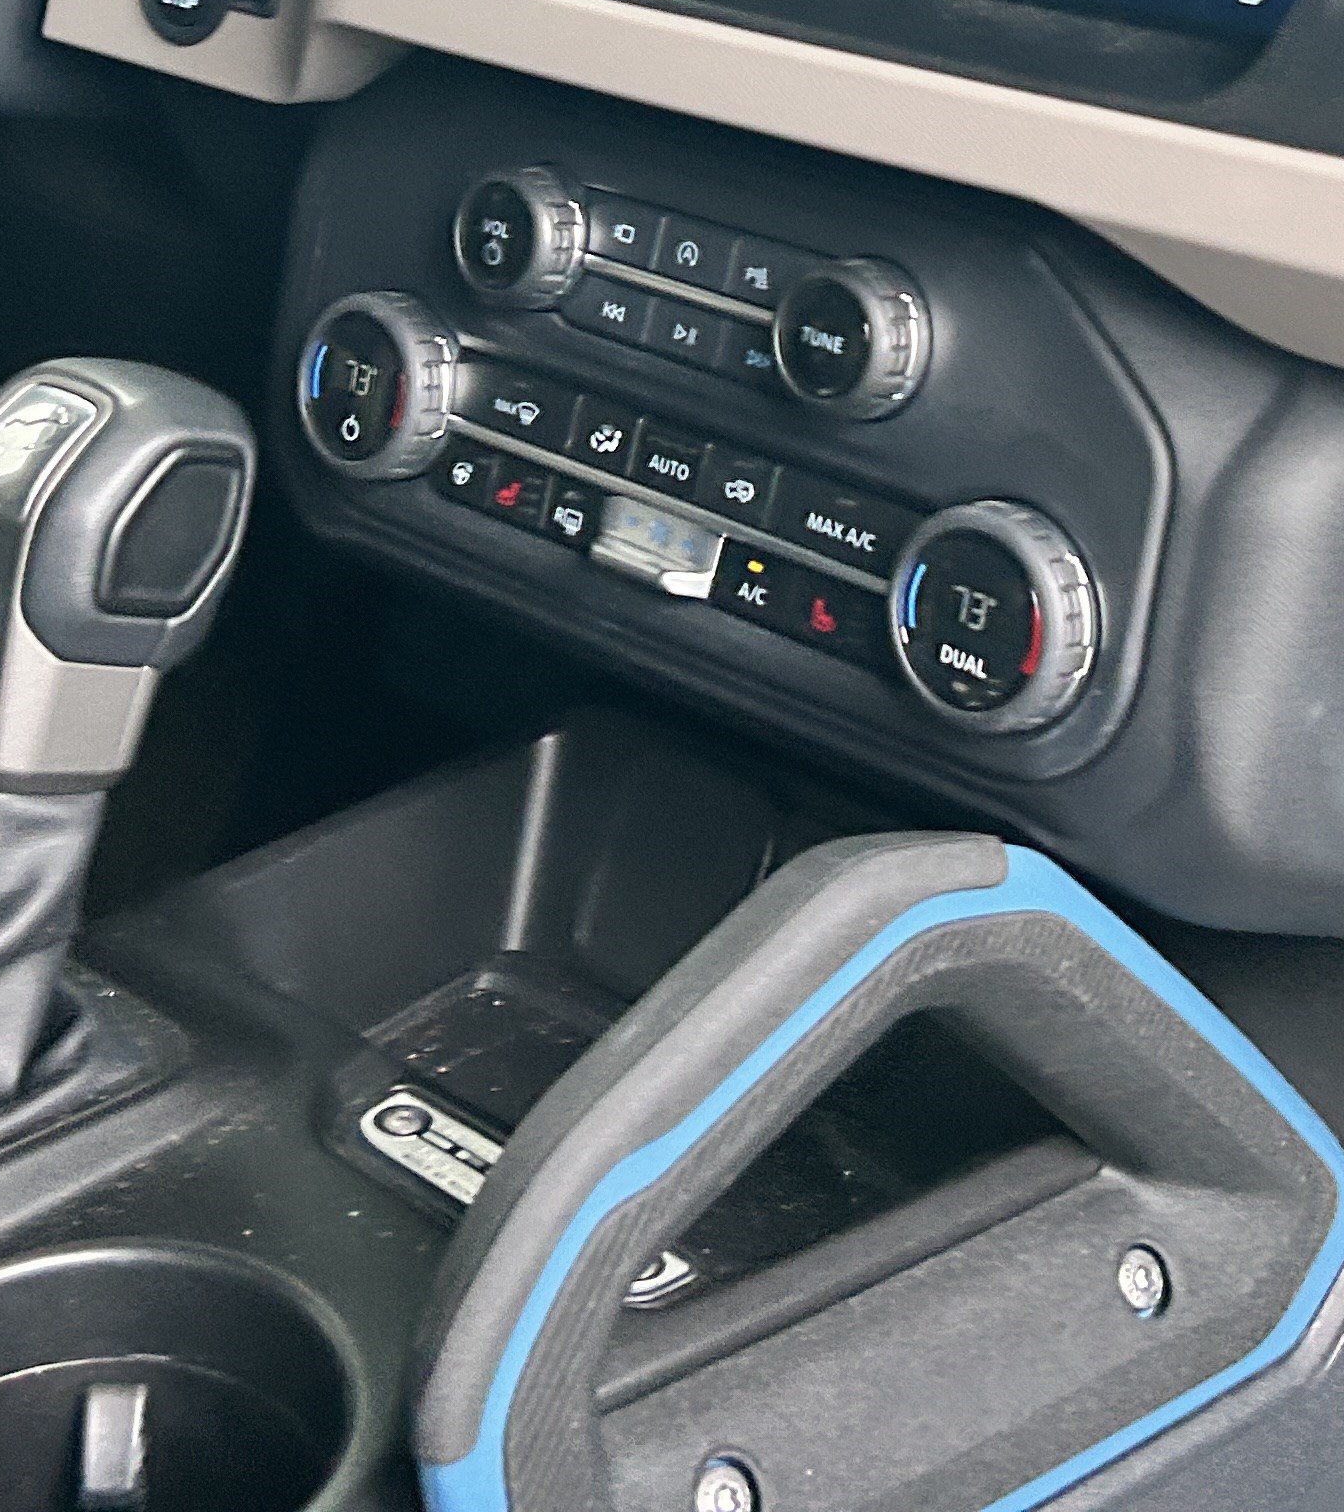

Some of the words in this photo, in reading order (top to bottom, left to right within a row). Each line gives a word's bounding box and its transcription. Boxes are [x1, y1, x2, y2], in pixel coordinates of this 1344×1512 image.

[800, 324, 845, 355] TUNE
[649, 454, 690, 481] AUTO
[805, 511, 844, 539] MAX
[842, 527, 878, 553] A/C
[737, 582, 767, 606] A/C
[940, 644, 988, 680] DUAL
